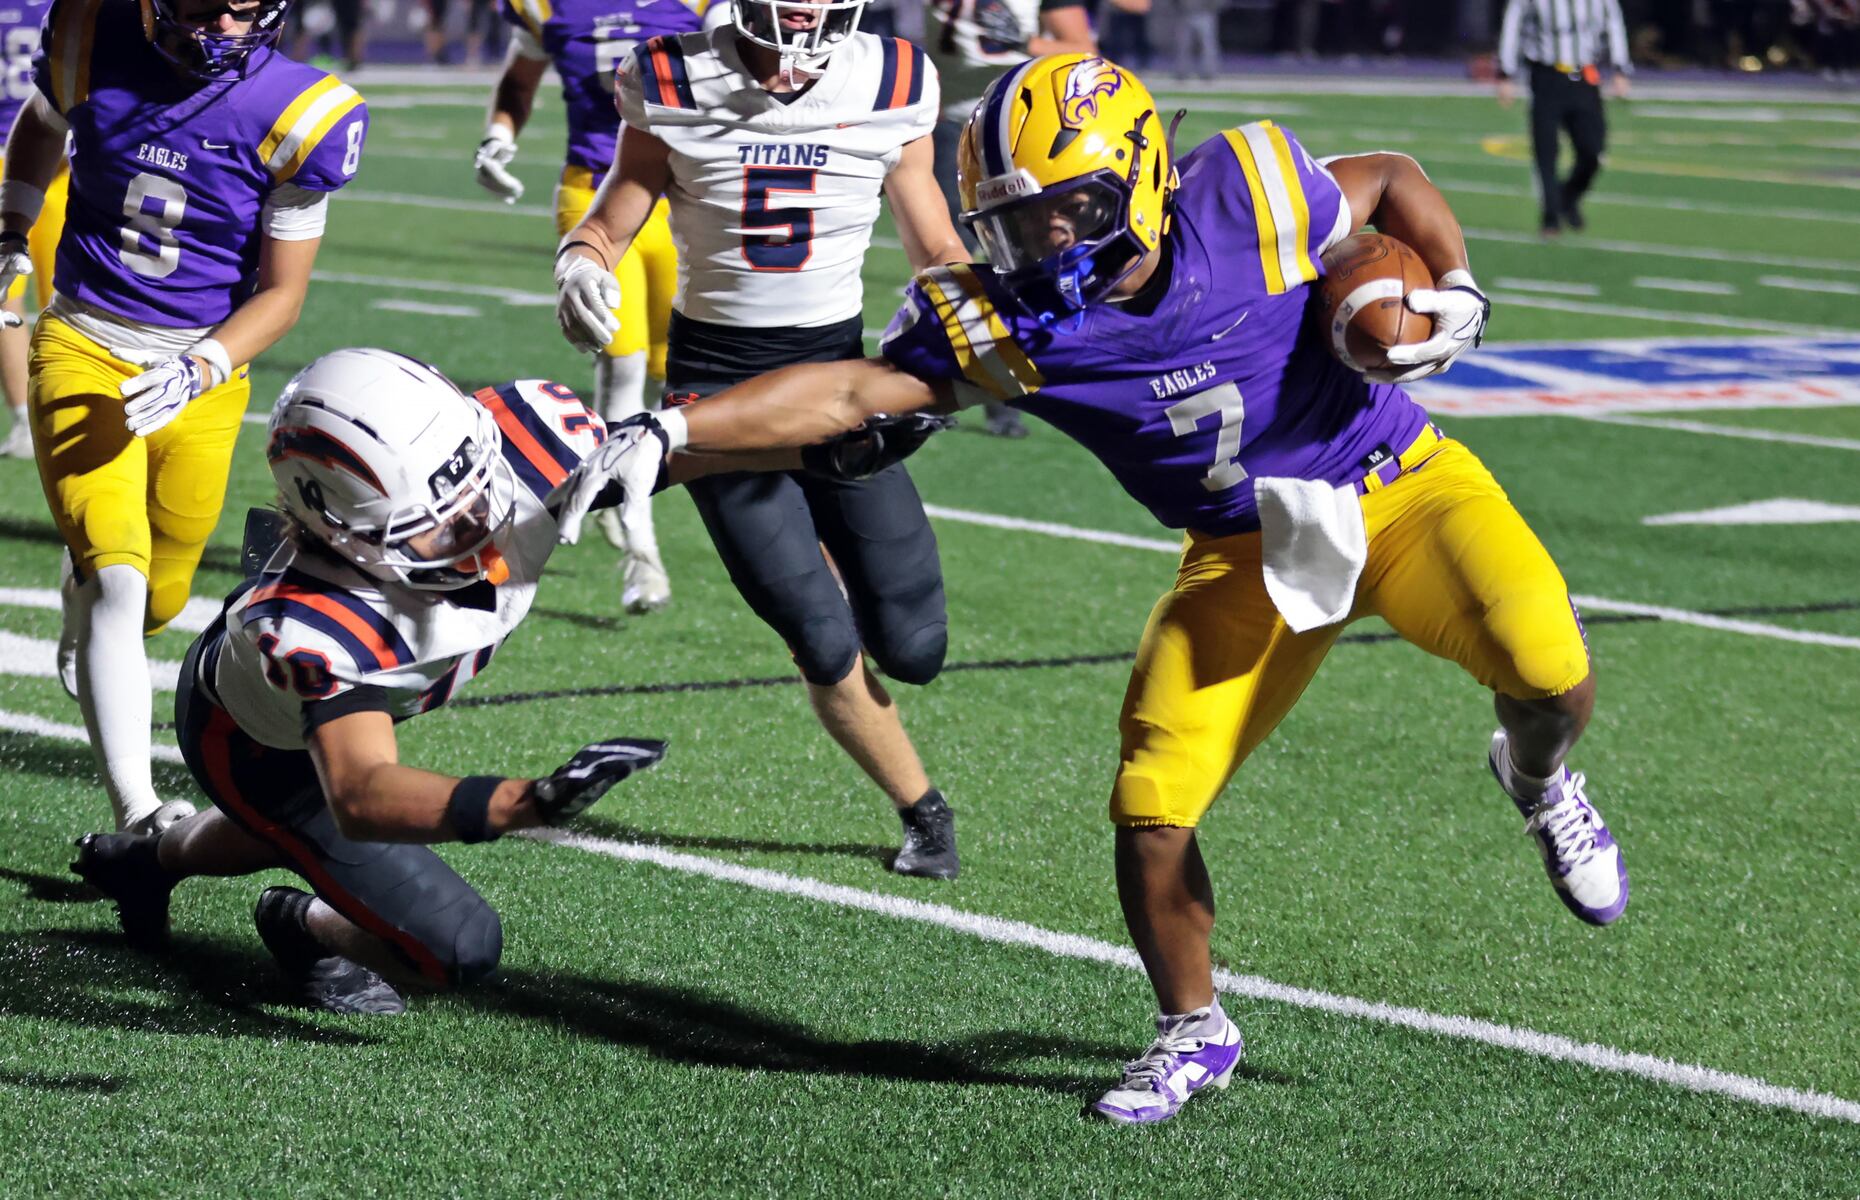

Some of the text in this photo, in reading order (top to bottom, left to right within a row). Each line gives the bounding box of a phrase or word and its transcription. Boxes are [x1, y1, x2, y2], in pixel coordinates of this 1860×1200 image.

[0, 26, 40, 100] 8
[137, 143, 188, 172] EAGLES
[342, 119, 364, 177] 8
[738, 144, 831, 167] TITANS
[977, 177, 1027, 201] Riddell
[119, 172, 188, 279] 8
[741, 165, 818, 272] 5
[1149, 360, 1217, 399] EAGLES
[1164, 380, 1249, 492] 7
[1368, 450, 1384, 464] M
[449, 455, 464, 475] F7
[256, 632, 340, 699] 10
